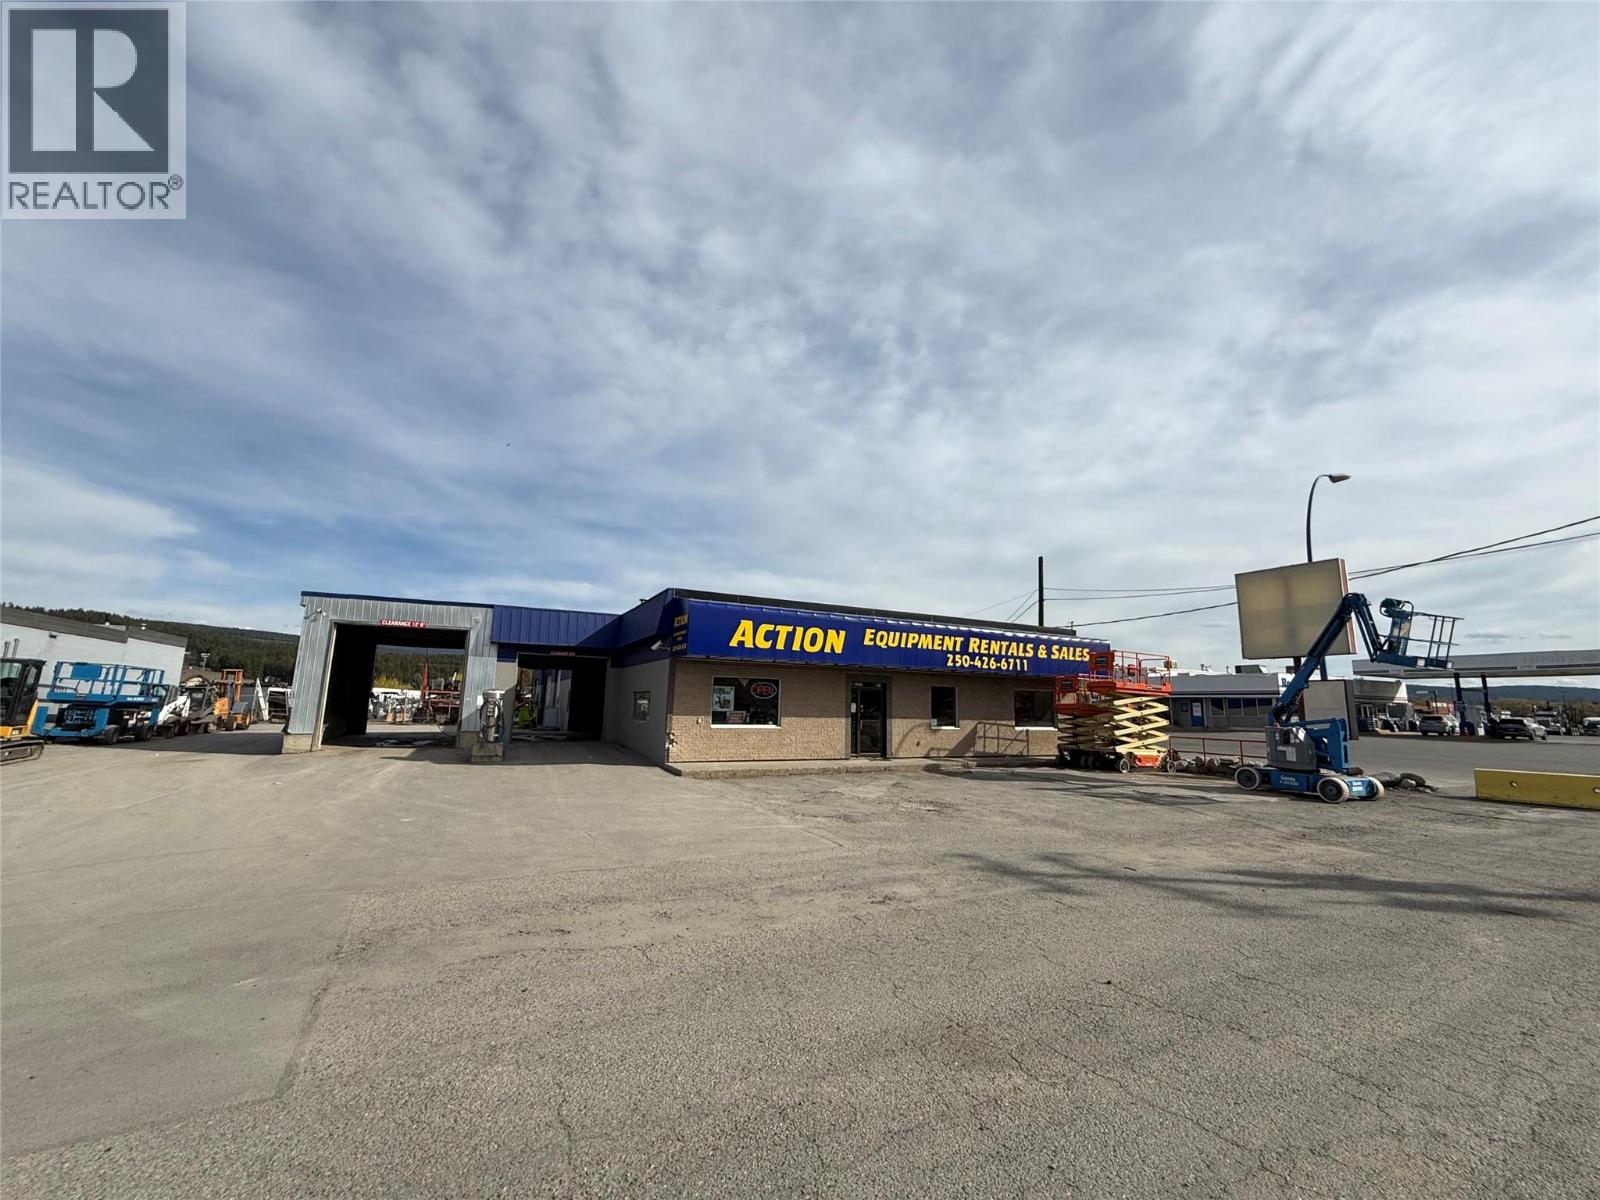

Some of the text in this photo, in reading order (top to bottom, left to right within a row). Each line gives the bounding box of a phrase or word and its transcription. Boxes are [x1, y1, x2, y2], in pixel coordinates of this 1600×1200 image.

[381, 619, 411, 627] CLEARANCE
[729, 619, 846, 654] ACTION
[863, 628, 964, 652] EQUIPMENT
[968, 637, 1034, 658] RENTALS
[1037, 644, 1048, 659] &
[1051, 645, 1090, 662] SALES
[946, 654, 1028, 671] 250-426-6711
[751, 685, 774, 696] OPEN
